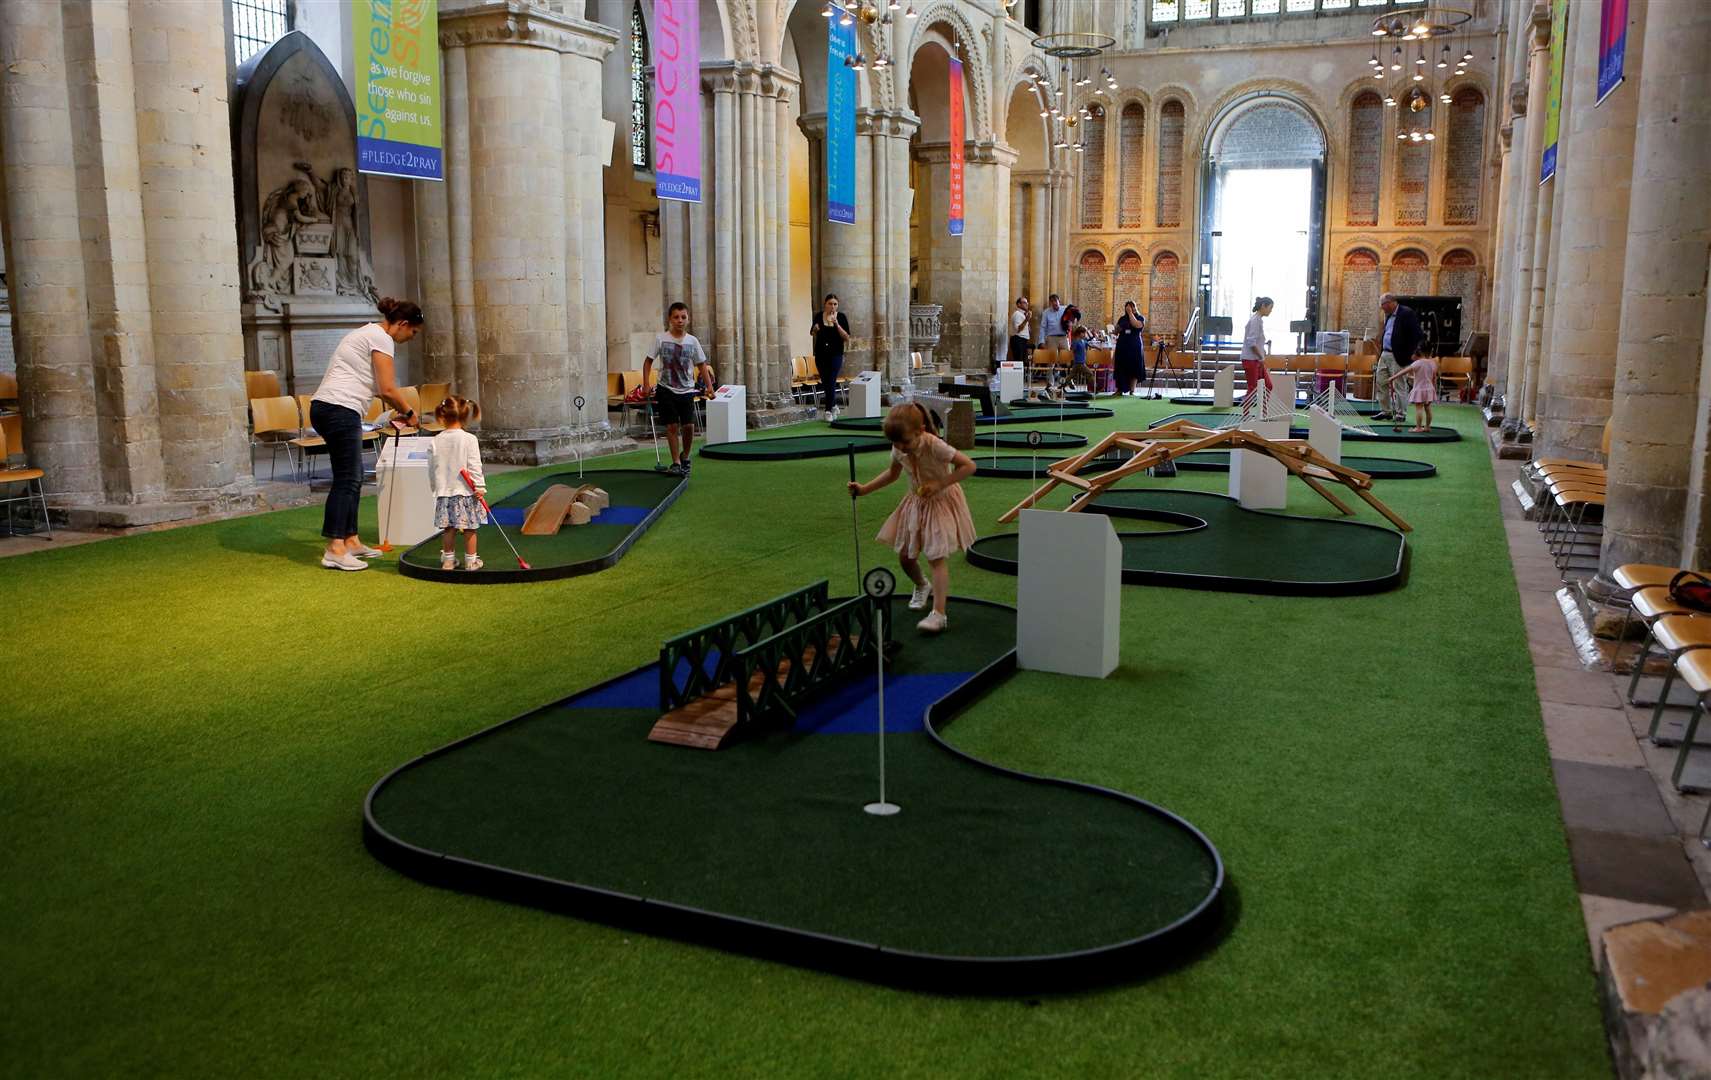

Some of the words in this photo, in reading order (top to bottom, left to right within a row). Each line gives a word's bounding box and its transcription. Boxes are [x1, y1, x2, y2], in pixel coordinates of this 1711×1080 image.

[370, 63, 381, 75] as
[383, 65, 398, 78] we
[399, 67, 432, 85] forgive
[368, 81, 394, 98] those
[397, 87, 416, 103] who
[419, 92, 432, 105] sin
[385, 108, 417, 124] against
[361, 149, 437, 172] #PLEDGE2PRAY
[874, 580, 885, 594] 9
